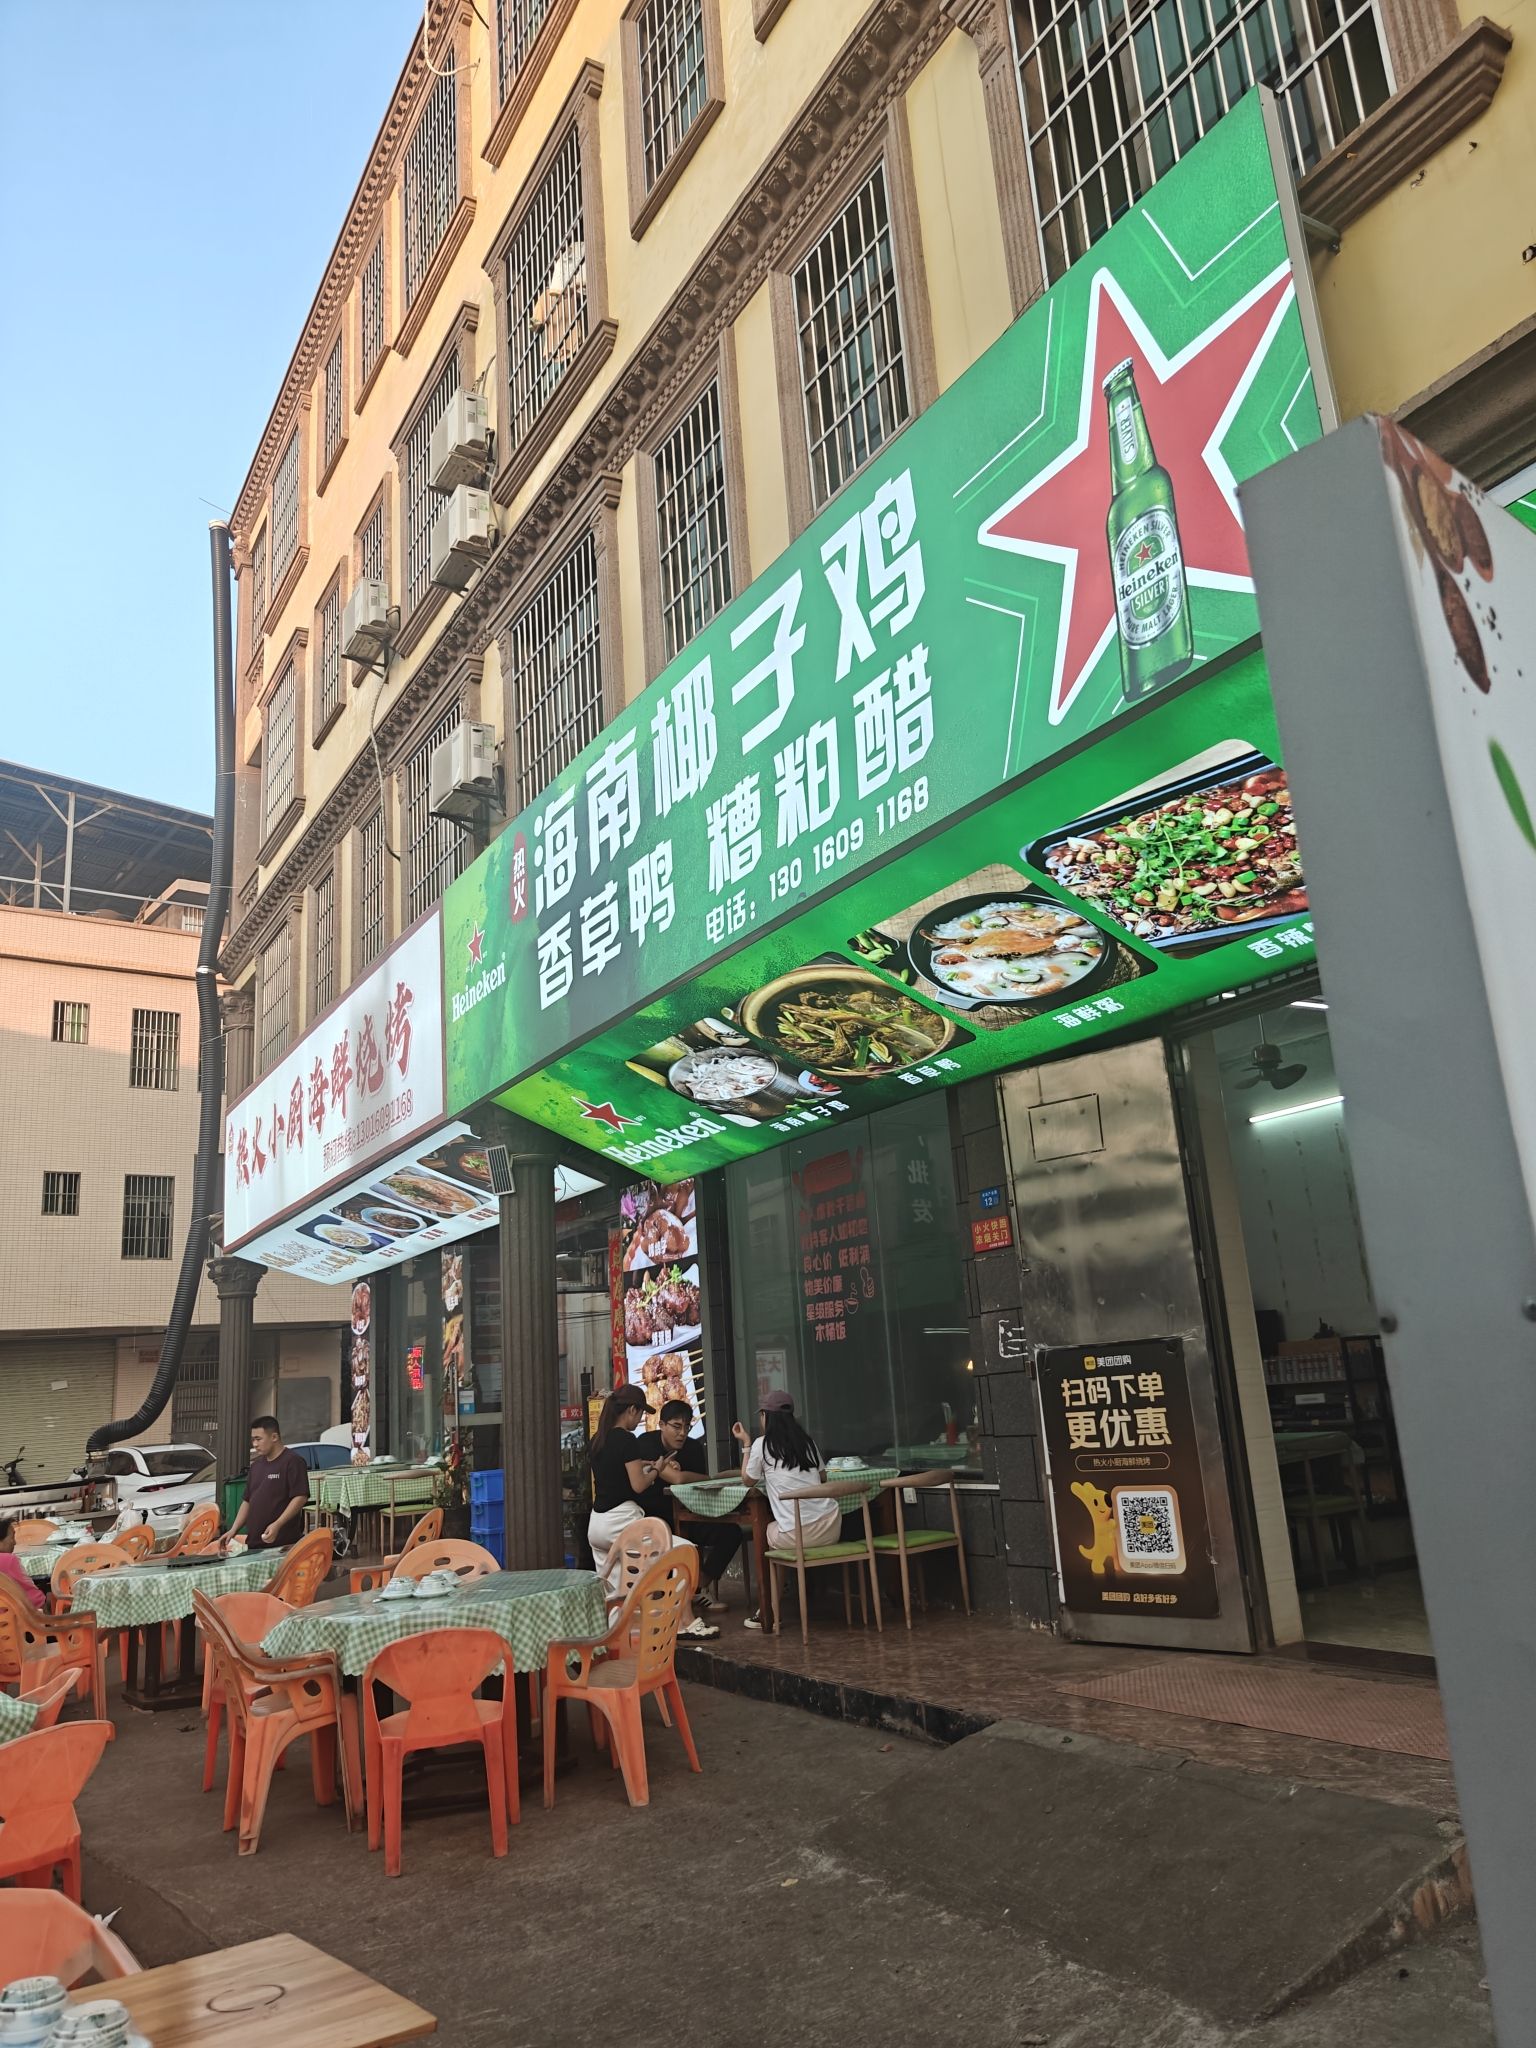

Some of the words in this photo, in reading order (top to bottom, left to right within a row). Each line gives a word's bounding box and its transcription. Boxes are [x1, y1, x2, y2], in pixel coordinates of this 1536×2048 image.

[1120, 415, 1134, 455] SILVER
[1119, 523, 1149, 571] HEINEKEN
[1150, 519, 1171, 538] SILVER
[1118, 550, 1179, 602] Heineken
[1134, 580, 1166, 611] SILVER
[1125, 618, 1140, 634] PURE
[1141, 615, 1161, 633] MALT
[1163, 587, 1178, 618] LAGER
[533, 466, 926, 919] 海南椰子鸡
[537, 839, 674, 1012] 香草鸭
[706, 642, 935, 896] 糟粕醋
[769, 857, 803, 902] 130
[812, 817, 865, 876] 1609
[876, 776, 931, 837] 1168
[513, 847, 526, 916] 热火
[452, 960, 507, 1023] Heineken
[1052, 996, 1125, 1028] 海鲜粥
[896, 1058, 962, 1085] 香草鸭
[769, 1100, 850, 1132] 海南椰子鸡
[601, 1114, 728, 1165] Heineken
[803, 1251, 833, 1274] 良心价
[838, 1244, 871, 1269] 低利润
[806, 1299, 846, 1321] 星级服务
[815, 1321, 847, 1343] 木桶饭
[1096, 1355, 1132, 1368] 美团团购
[1061, 1371, 1165, 1407] 扫码下单
[1065, 1406, 1172, 1450] 更优惠
